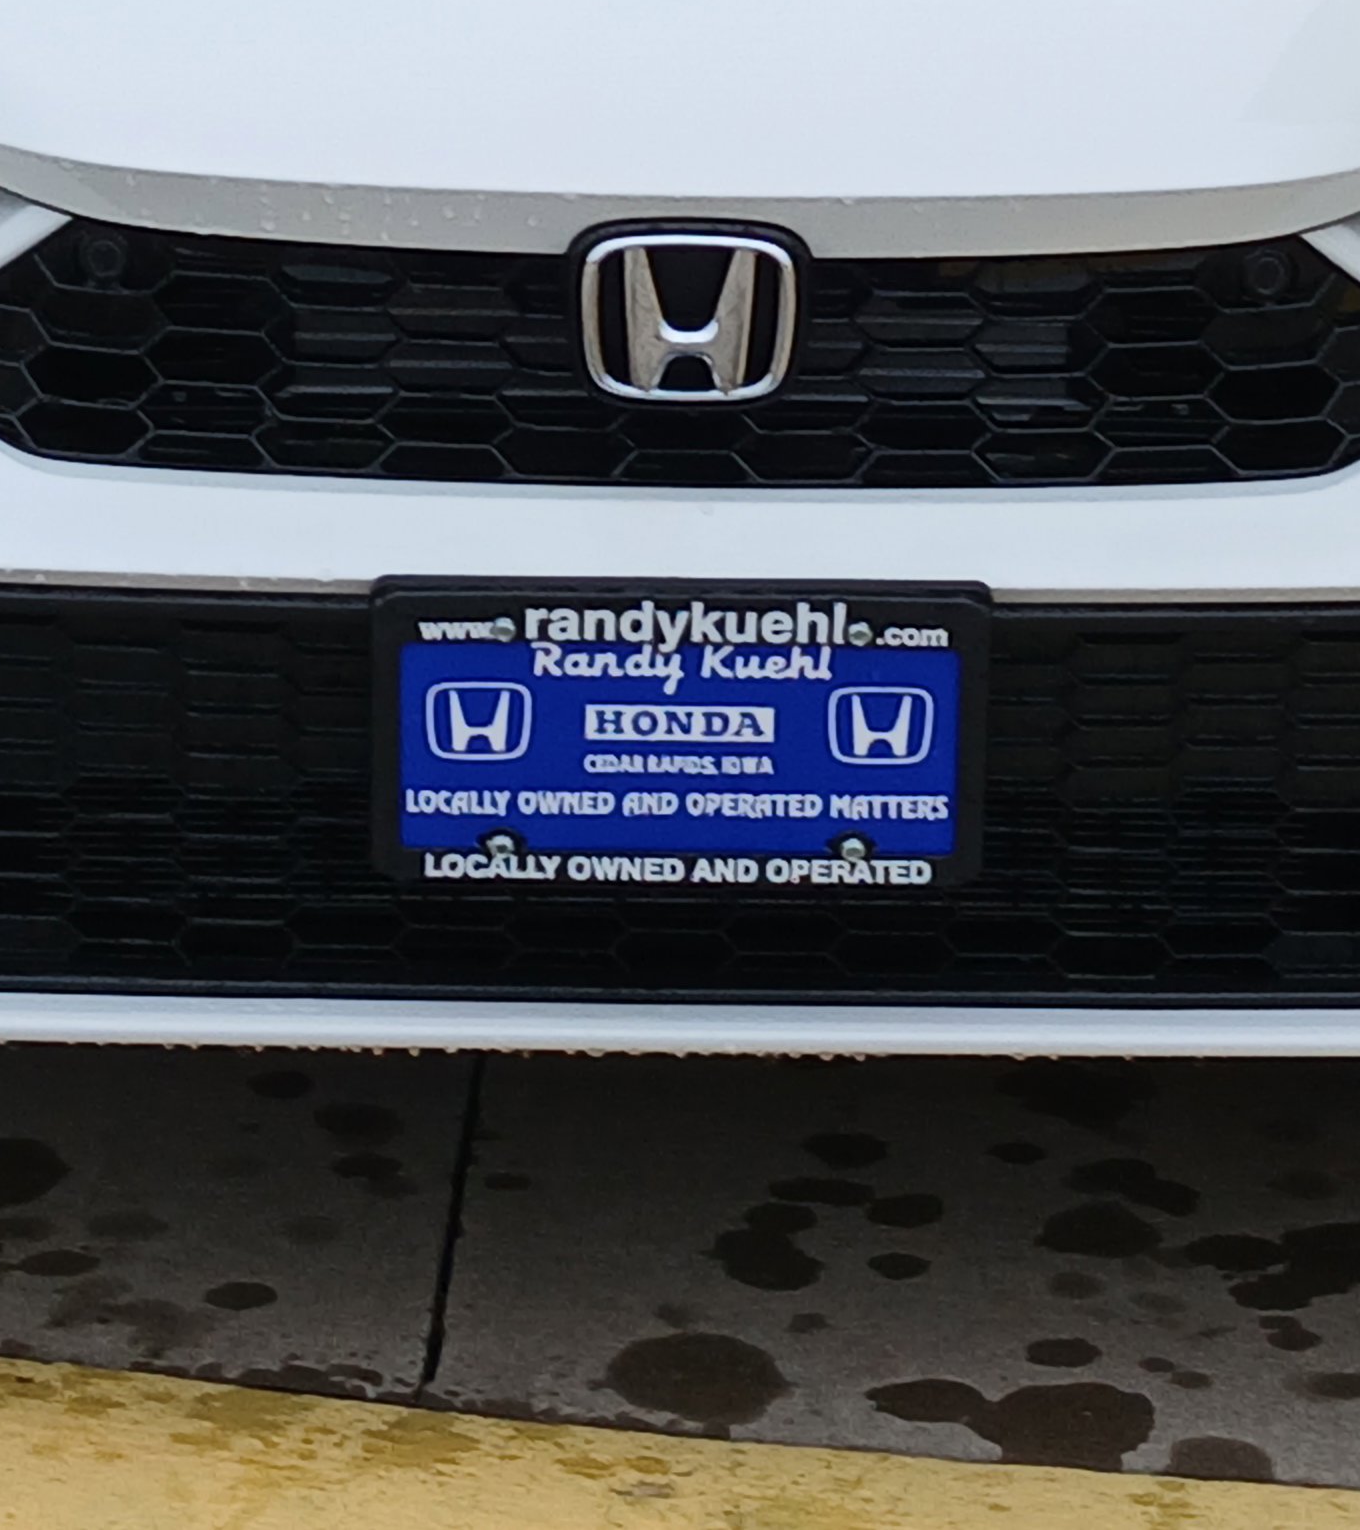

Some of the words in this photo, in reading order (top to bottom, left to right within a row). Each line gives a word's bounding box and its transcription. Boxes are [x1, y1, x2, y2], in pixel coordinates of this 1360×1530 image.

[525, 600, 847, 653] randykuehl
[875, 627, 949, 647] .com
[531, 641, 684, 695] Randy
[701, 644, 832, 680] Kuehl
[594, 710, 765, 737] HONDA
[406, 788, 511, 816] LOCALLY
[517, 790, 616, 815] OWNED
[622, 791, 679, 817] AND
[685, 792, 823, 819] OPERATED
[829, 794, 949, 820] MATTERS
[424, 852, 561, 880] LOCALLY
[567, 856, 685, 882] OWNED
[690, 858, 759, 883] AND
[765, 858, 931, 885] OPERATED
